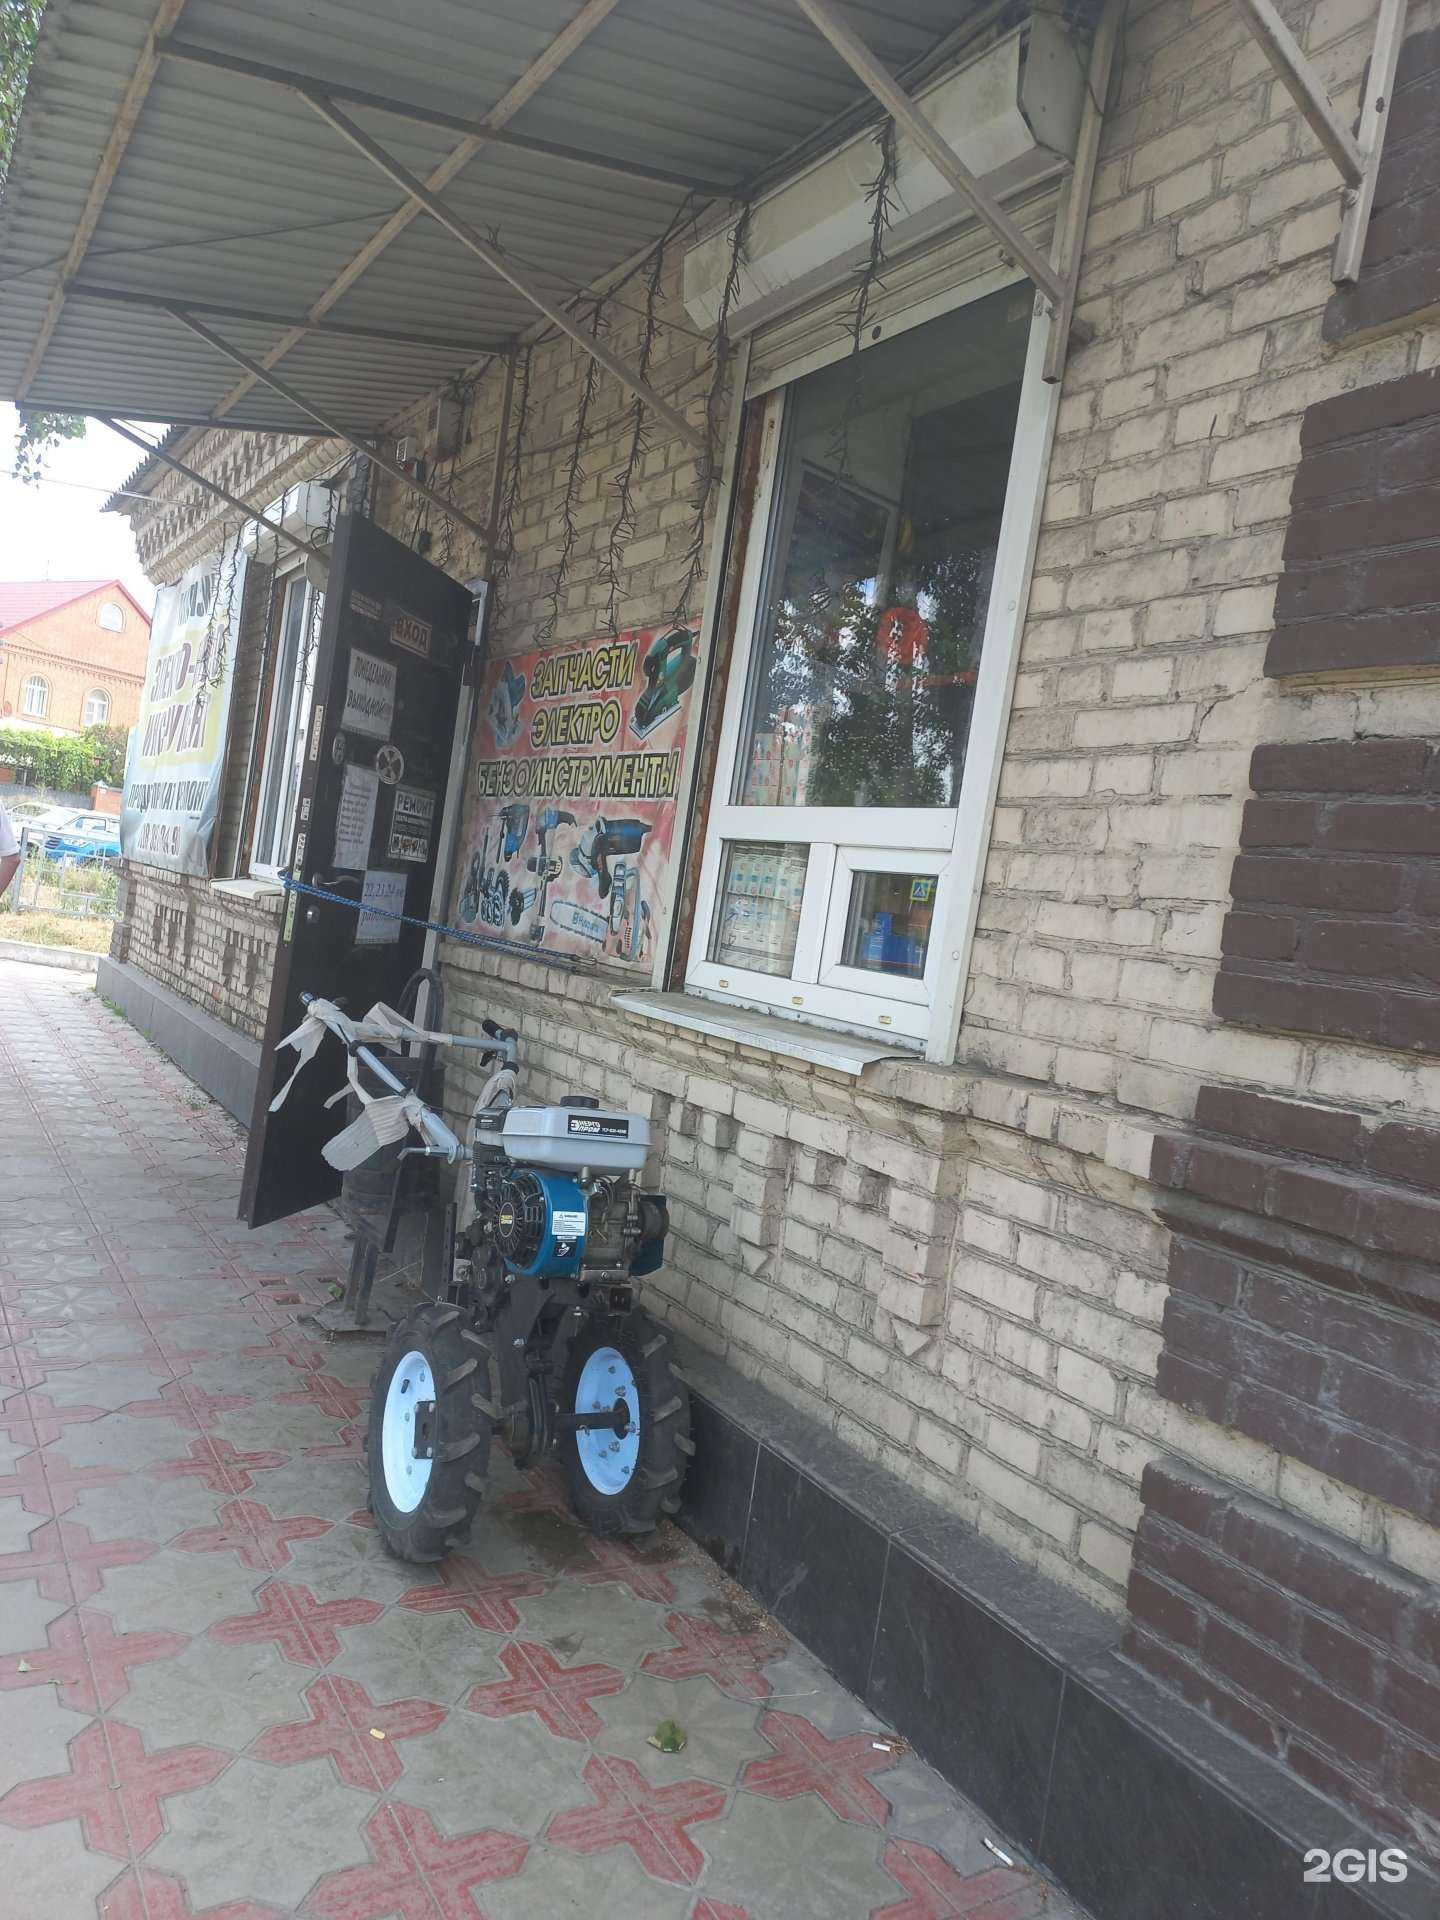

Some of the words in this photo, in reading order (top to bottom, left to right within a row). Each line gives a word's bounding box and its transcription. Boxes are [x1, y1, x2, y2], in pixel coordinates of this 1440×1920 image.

[396, 615, 429, 651] ВХОД
[530, 641, 637, 700] ЗАПЧАСТИ
[346, 688, 386, 718] ВЫХОДНОЙ
[531, 701, 621, 748] ЭЛЕКТРО
[477, 752, 680, 799] БЕНЗОИНСТРУМЕНТЫ
[397, 793, 434, 818] РЕМОНТ
